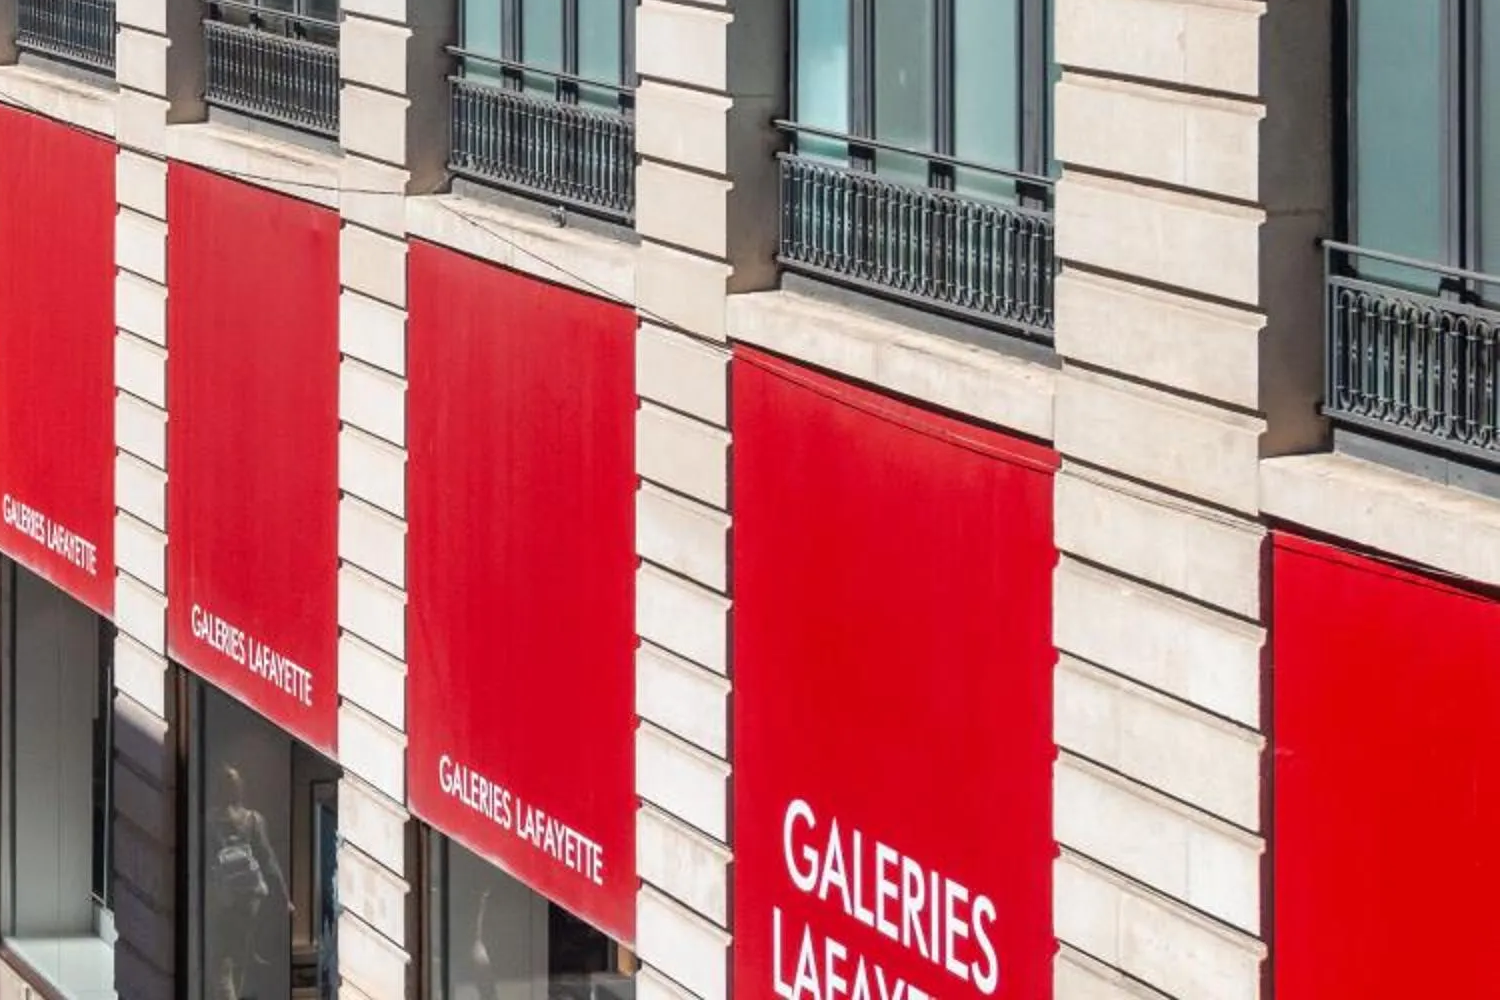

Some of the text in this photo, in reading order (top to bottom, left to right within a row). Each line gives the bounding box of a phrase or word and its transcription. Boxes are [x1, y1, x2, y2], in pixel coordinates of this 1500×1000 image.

[3, 493, 97, 577] GALERIES LAFAYETTE
[191, 603, 313, 708] GALERIES LAFAYETTE
[438, 754, 604, 886] GALERIES LAFAYETTE
[783, 797, 999, 996] GALERIES
